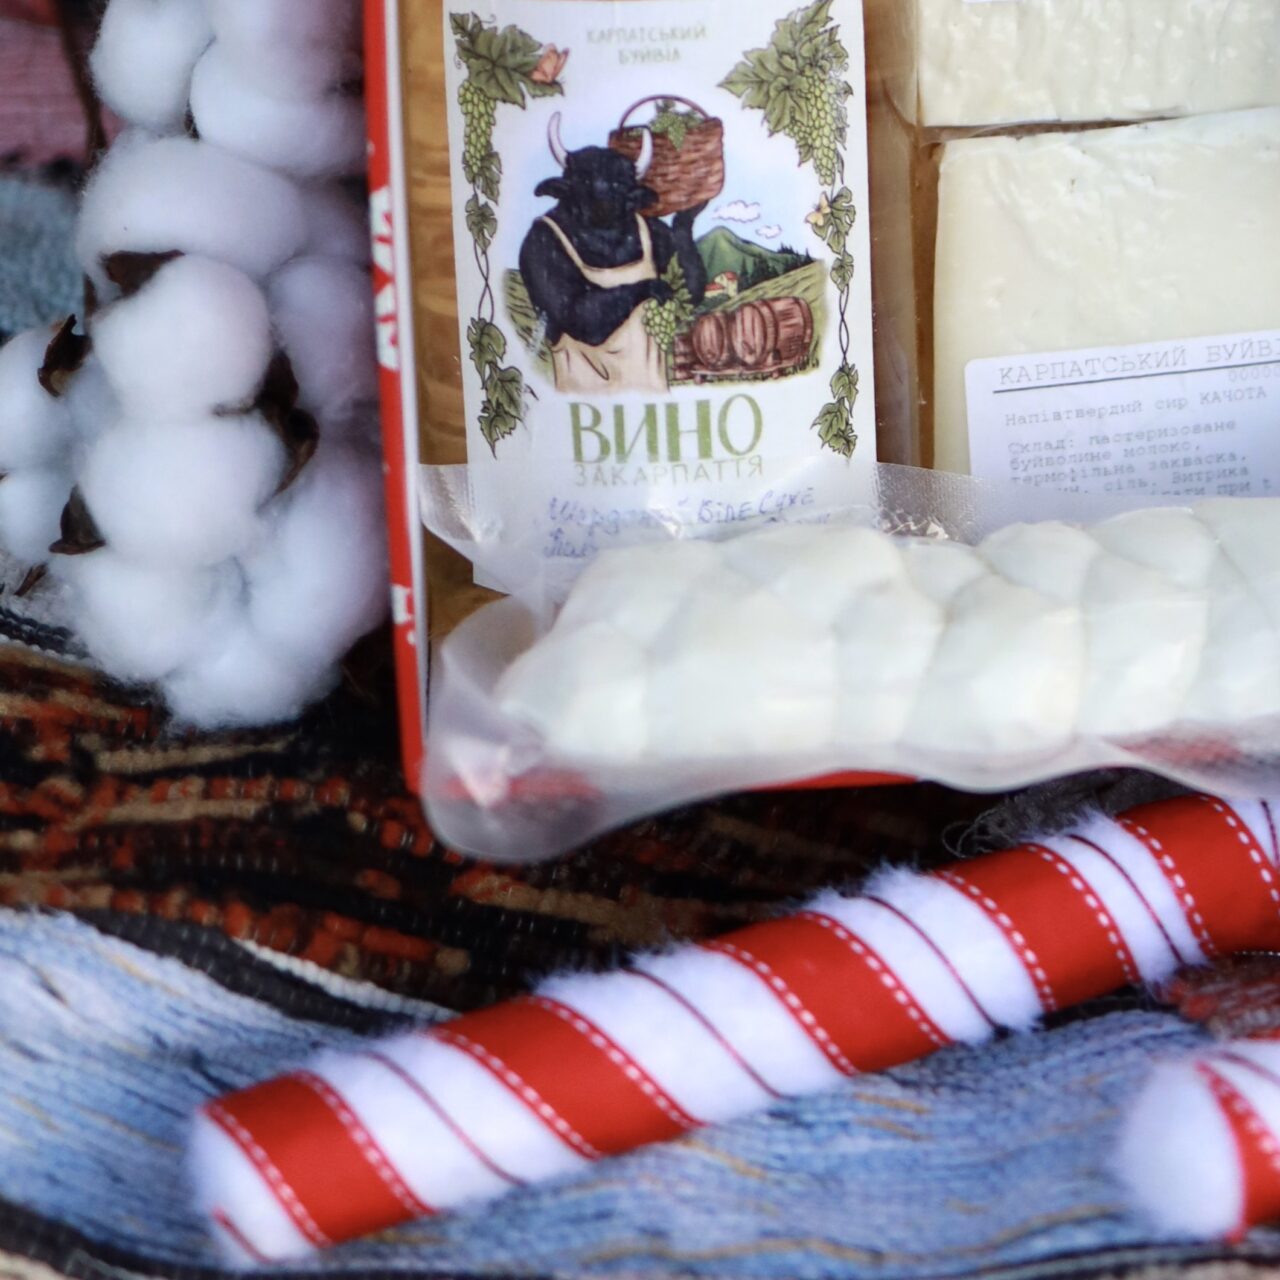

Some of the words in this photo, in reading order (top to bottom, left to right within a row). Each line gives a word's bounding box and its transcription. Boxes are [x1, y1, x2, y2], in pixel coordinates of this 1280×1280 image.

[586, 24, 707, 44] КАРПАТСЬКИЙ
[618, 47, 682, 65] БУЙВІЛ
[999, 344, 1187, 385] КАРПАТСЬКИЙ
[1005, 400, 1143, 427] Напівтвердий
[1154, 398, 1189, 411] сир
[1199, 386, 1267, 405] КАЧОТА
[568, 393, 763, 464] ВИНО
[1007, 437, 1074, 455] Склад:
[1089, 420, 1237, 446] пастеризоване
[575, 454, 763, 487] ЗАКАРПАТТЯ
[1009, 451, 1112, 472] буйволине
